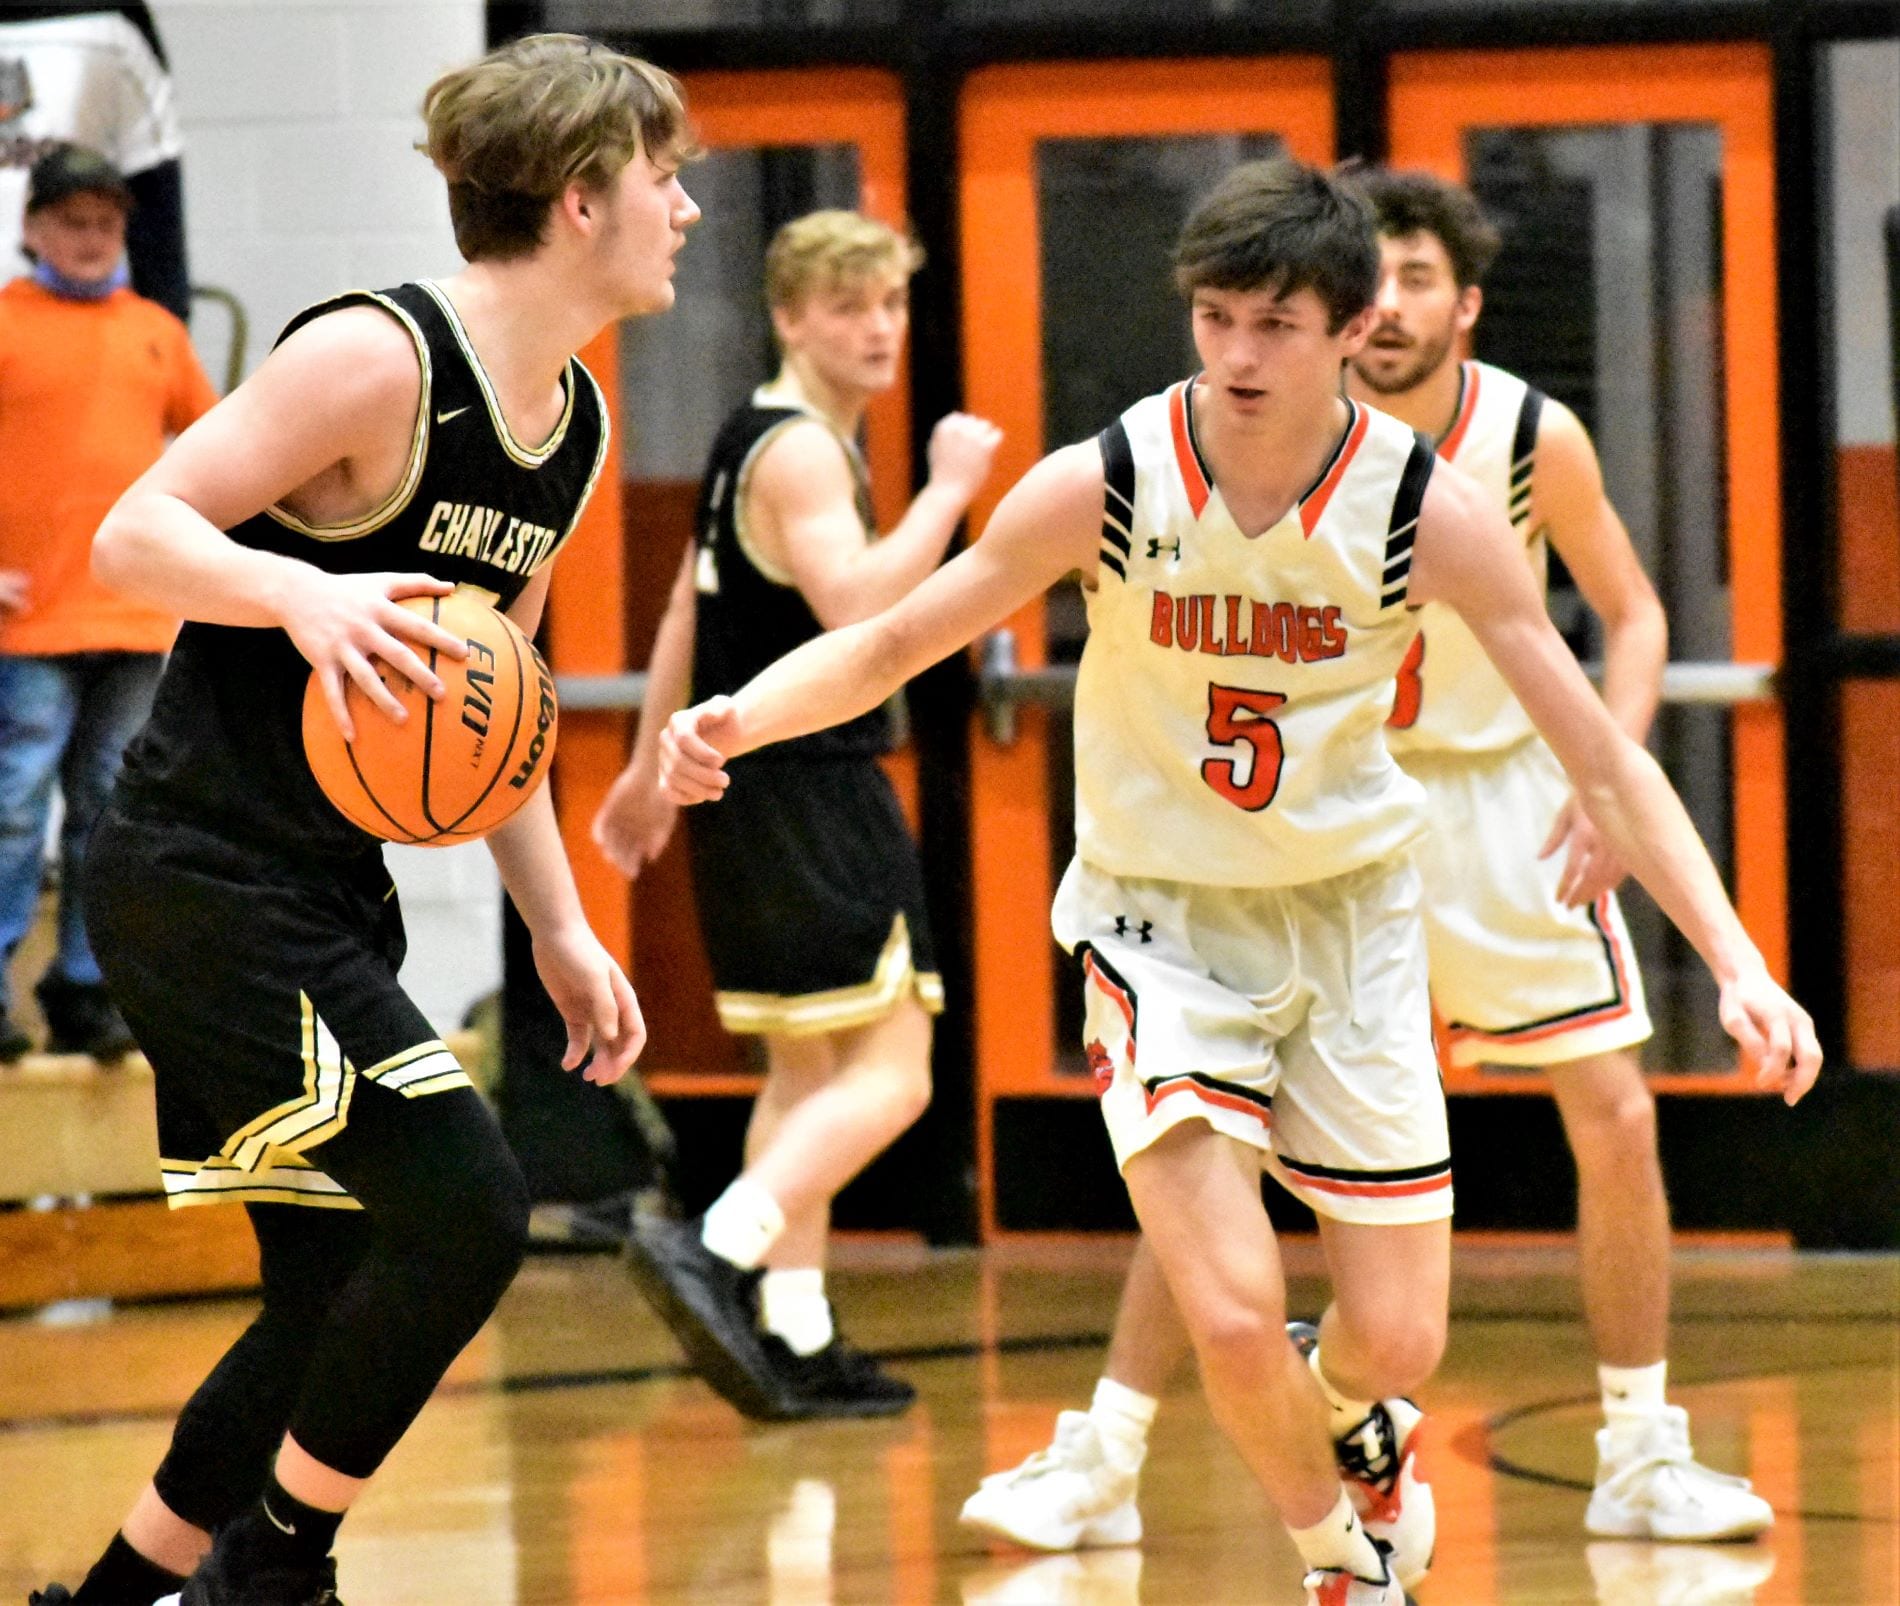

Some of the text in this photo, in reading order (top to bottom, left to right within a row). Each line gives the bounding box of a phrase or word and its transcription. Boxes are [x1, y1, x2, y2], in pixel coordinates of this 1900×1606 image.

[1150, 590, 1348, 664] BULLDOGS
[462, 638, 494, 737] EVO
[1200, 681, 1288, 812] 5
